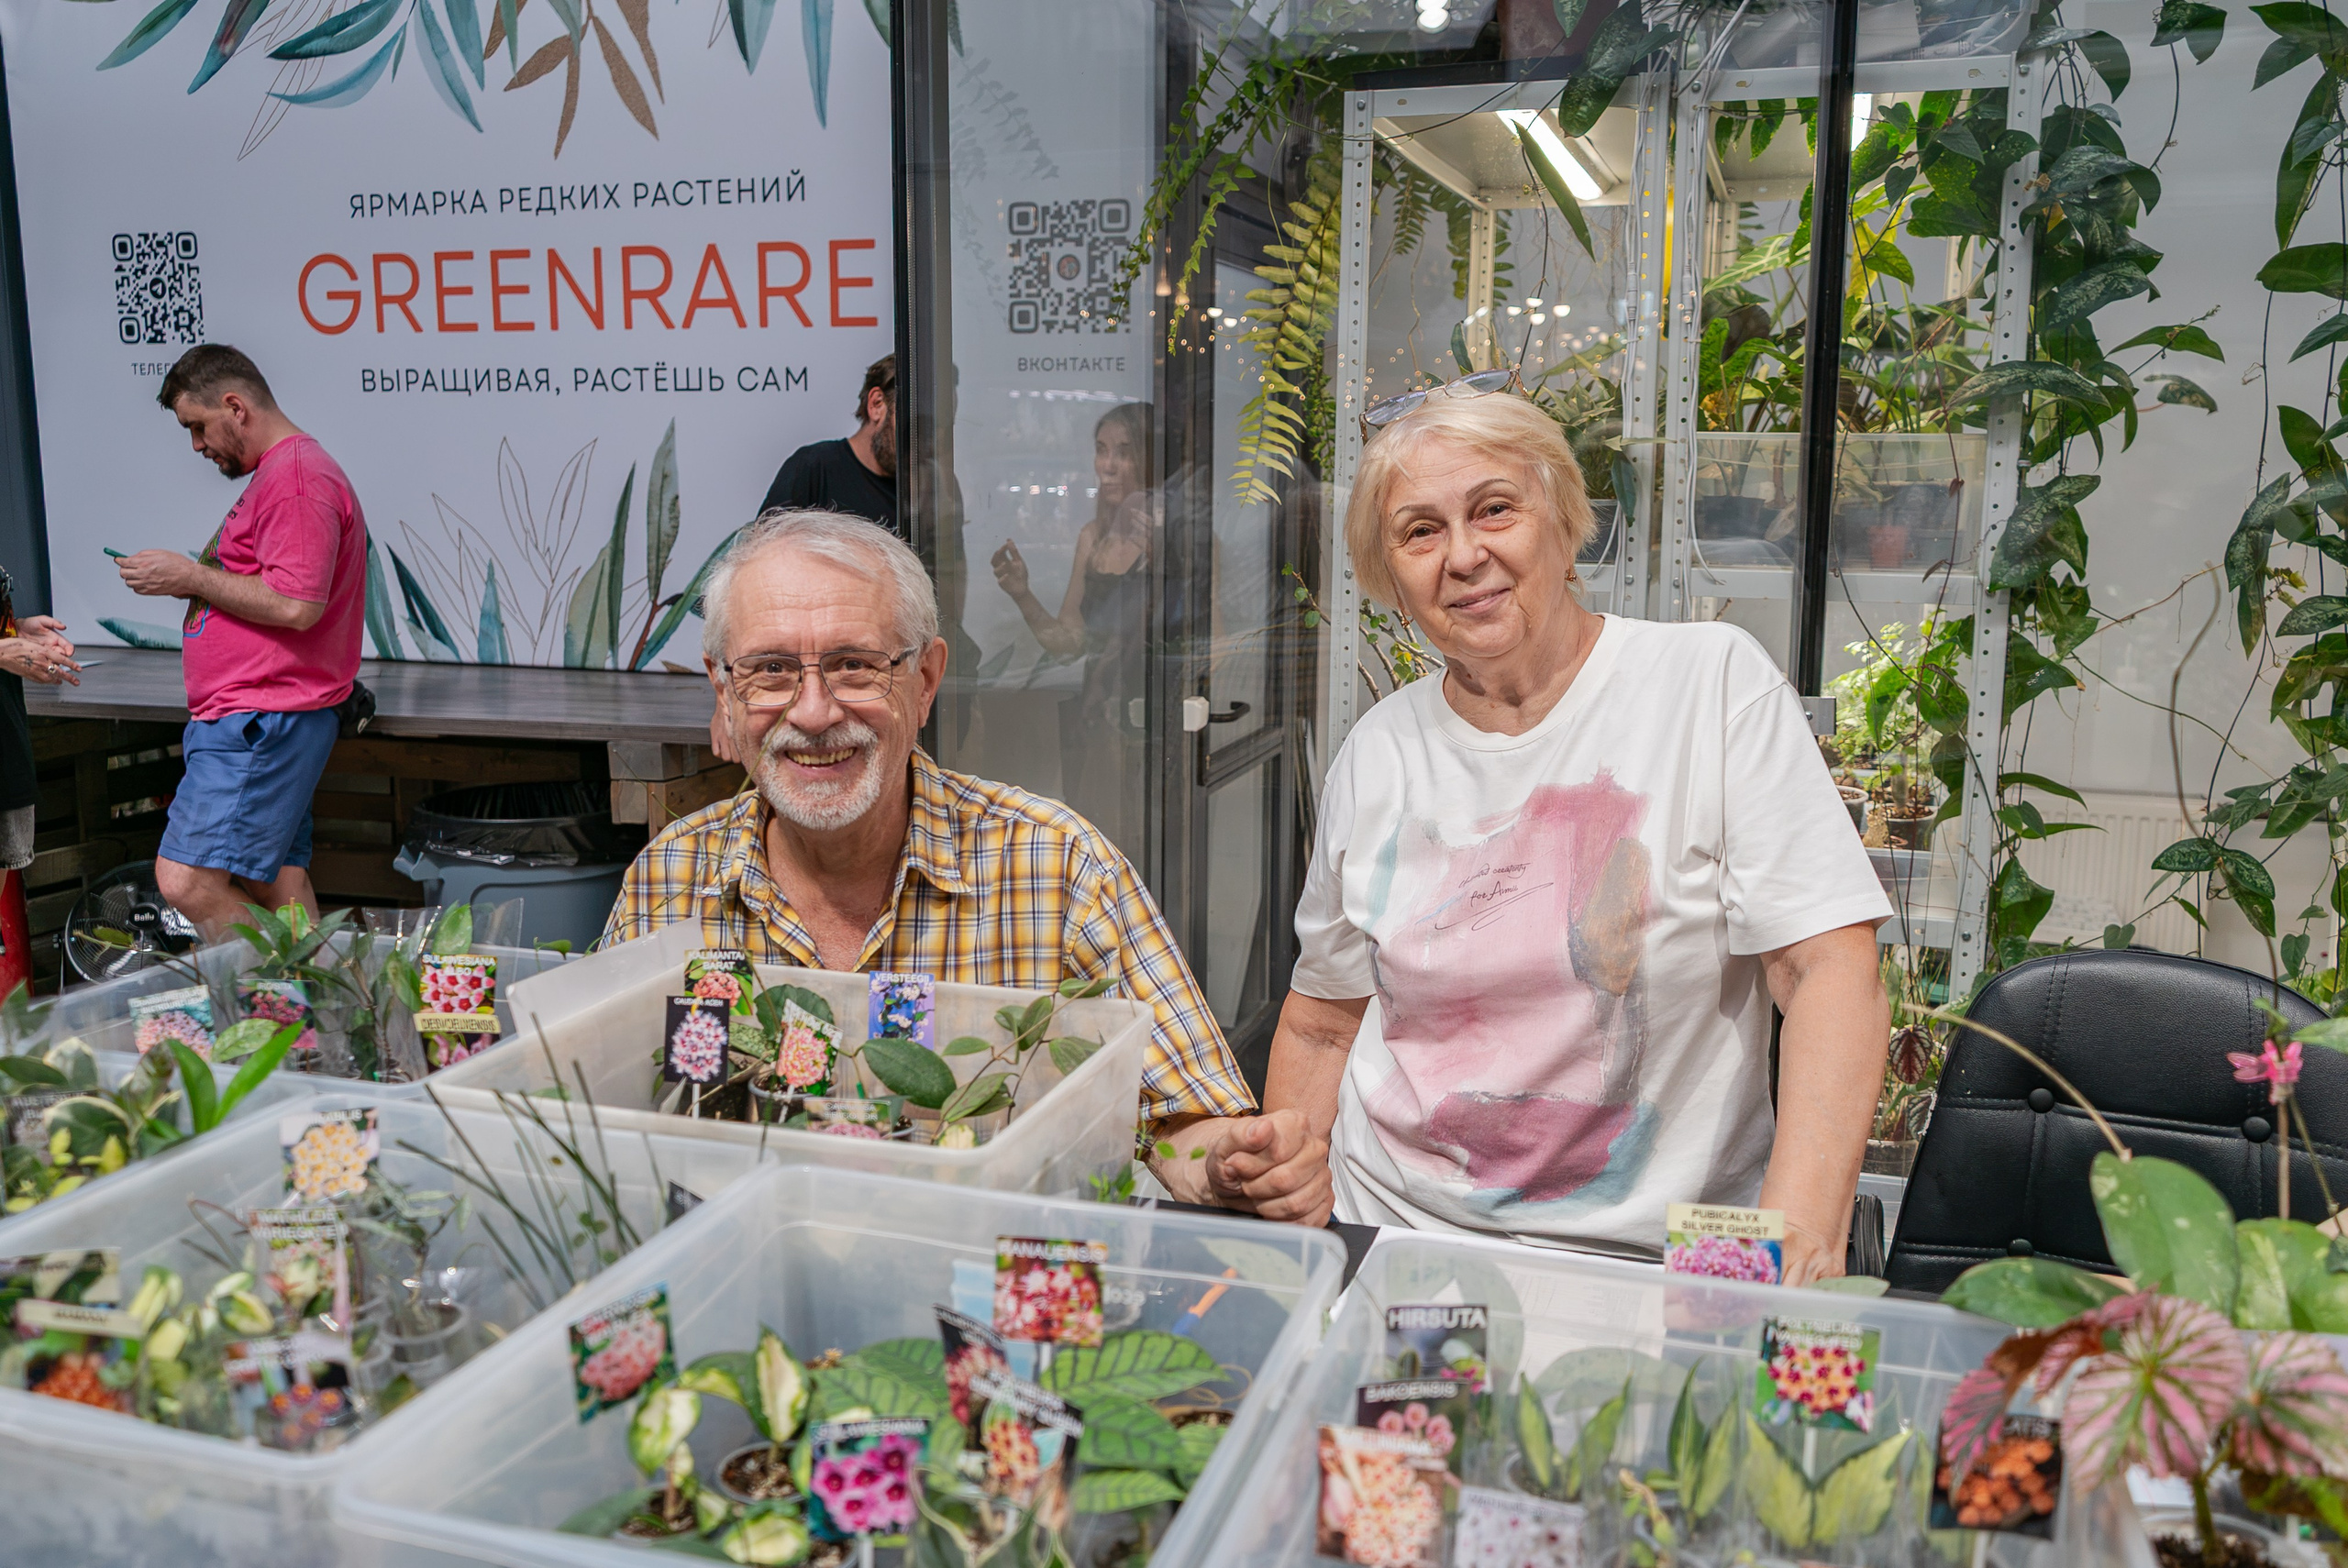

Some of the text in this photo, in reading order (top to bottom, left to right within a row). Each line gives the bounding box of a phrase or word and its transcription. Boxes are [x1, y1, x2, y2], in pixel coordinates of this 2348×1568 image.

[349, 168, 805, 219] ЯРМАРКА РЕДКИХ РАСТЕНИЙ
[298, 238, 879, 336] GREENRARE
[131, 362, 175, 376] ТЕЛЕГ
[1017, 357, 1125, 371] ВКОНТАКТЕ
[361, 361, 808, 397] ВЫРАЩИВАЯ, РАСТЁШЬ САМ
[422, 954, 496, 966] SULAWESIANA
[689, 950, 746, 961] KALIMANTA
[703, 961, 736, 971] BARAT
[874, 973, 930, 984] VERSTEEGII
[1691, 1208, 1760, 1224] PUBICALYX
[1681, 1220, 1770, 1236] SILVER GHOST
[1388, 1308, 1488, 1330] HIRSUTA
